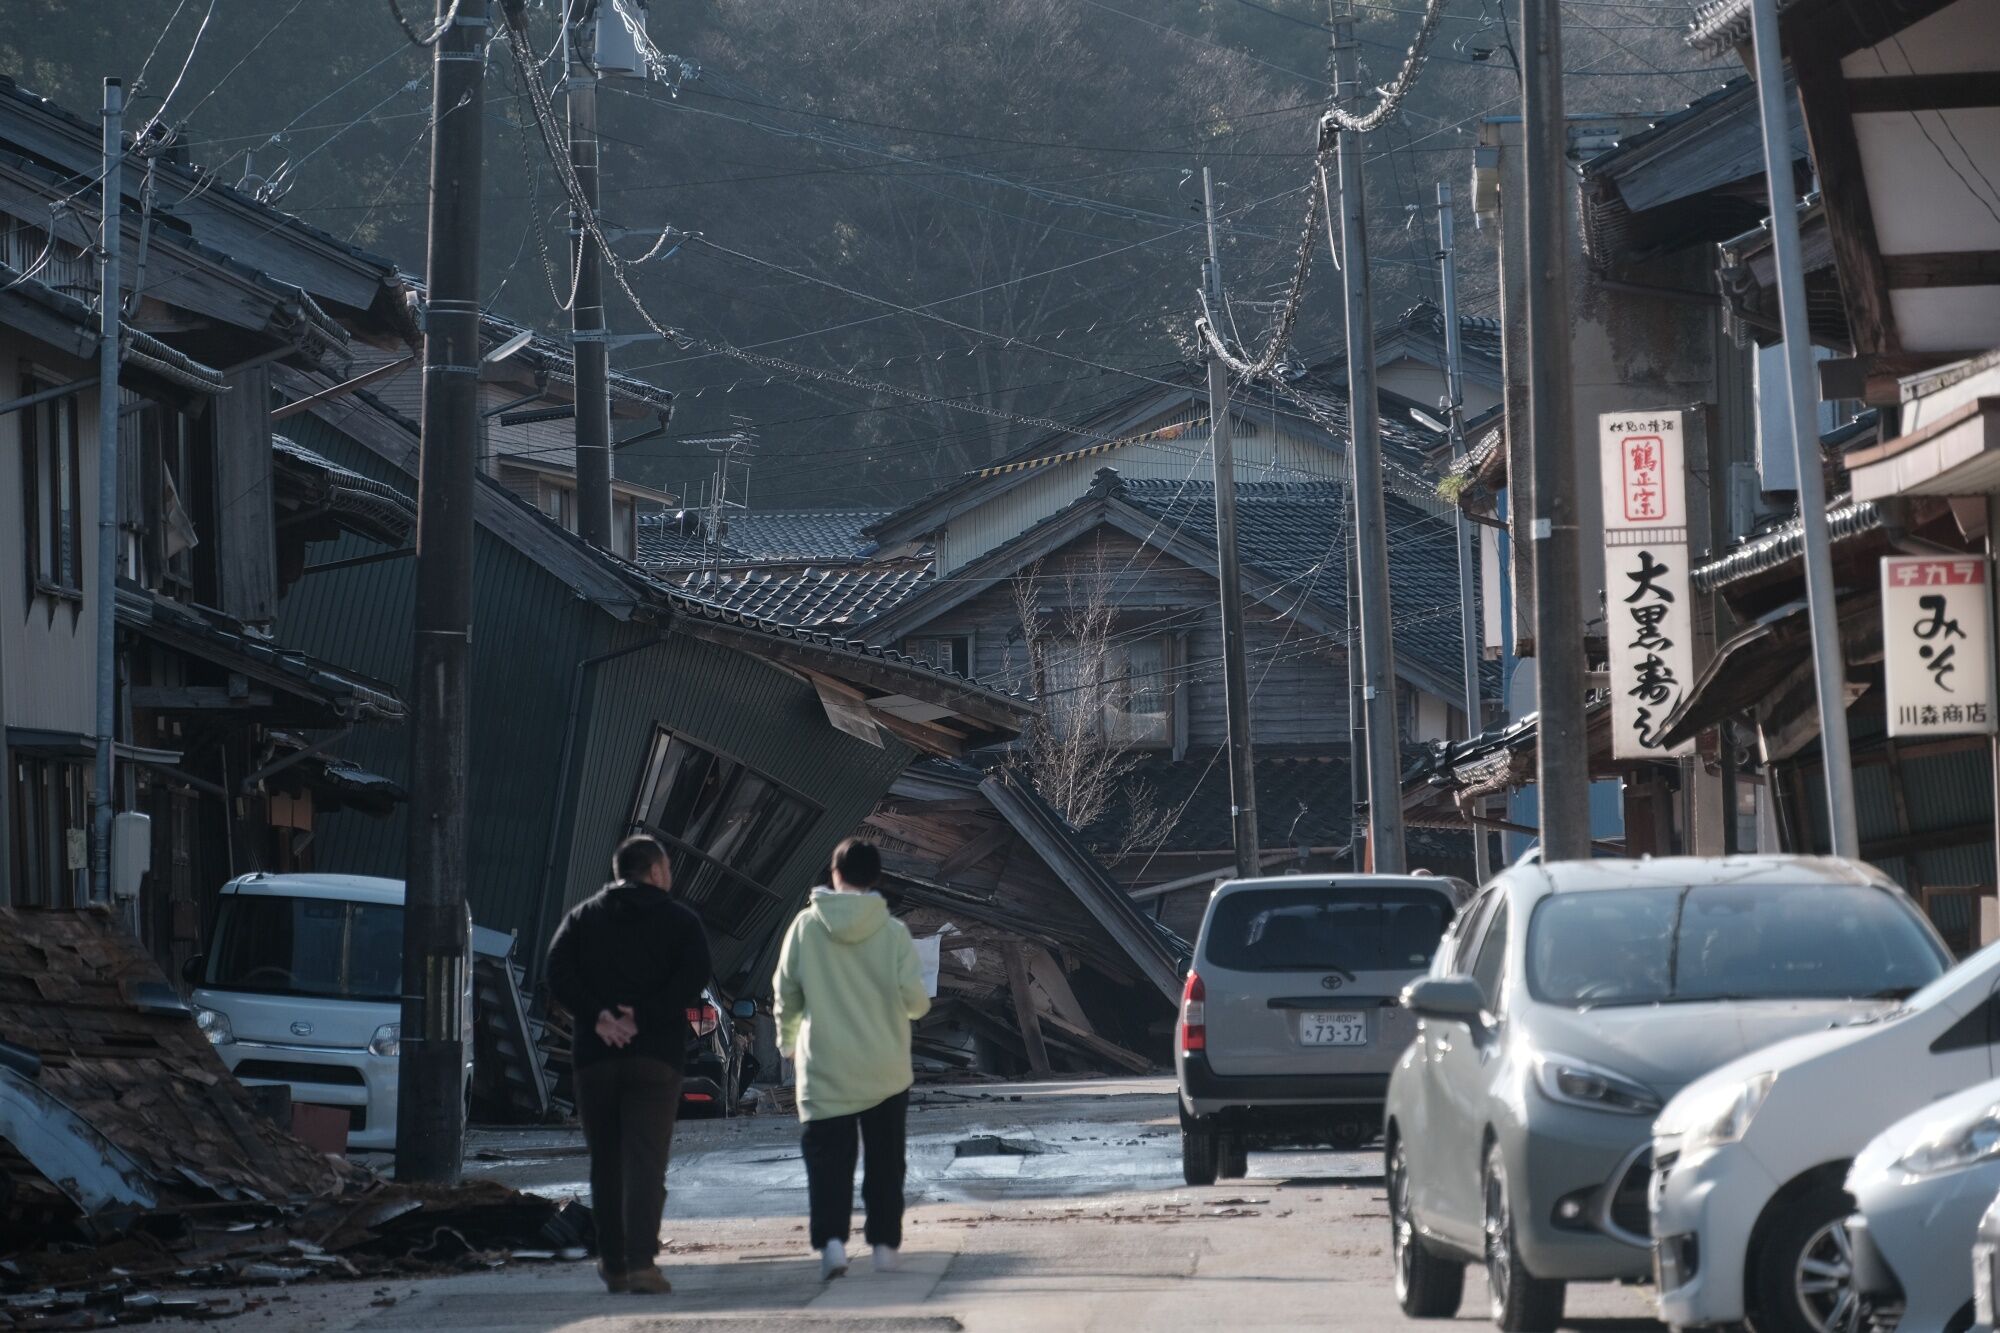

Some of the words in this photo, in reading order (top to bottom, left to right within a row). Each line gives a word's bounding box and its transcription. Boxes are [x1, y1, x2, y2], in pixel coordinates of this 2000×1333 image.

[1631, 442, 1657, 515] 鶴正宗
[1897, 563, 1974, 586] チカラ
[1913, 594, 1966, 693] みそ
[1900, 702, 1987, 726] 川森商店
